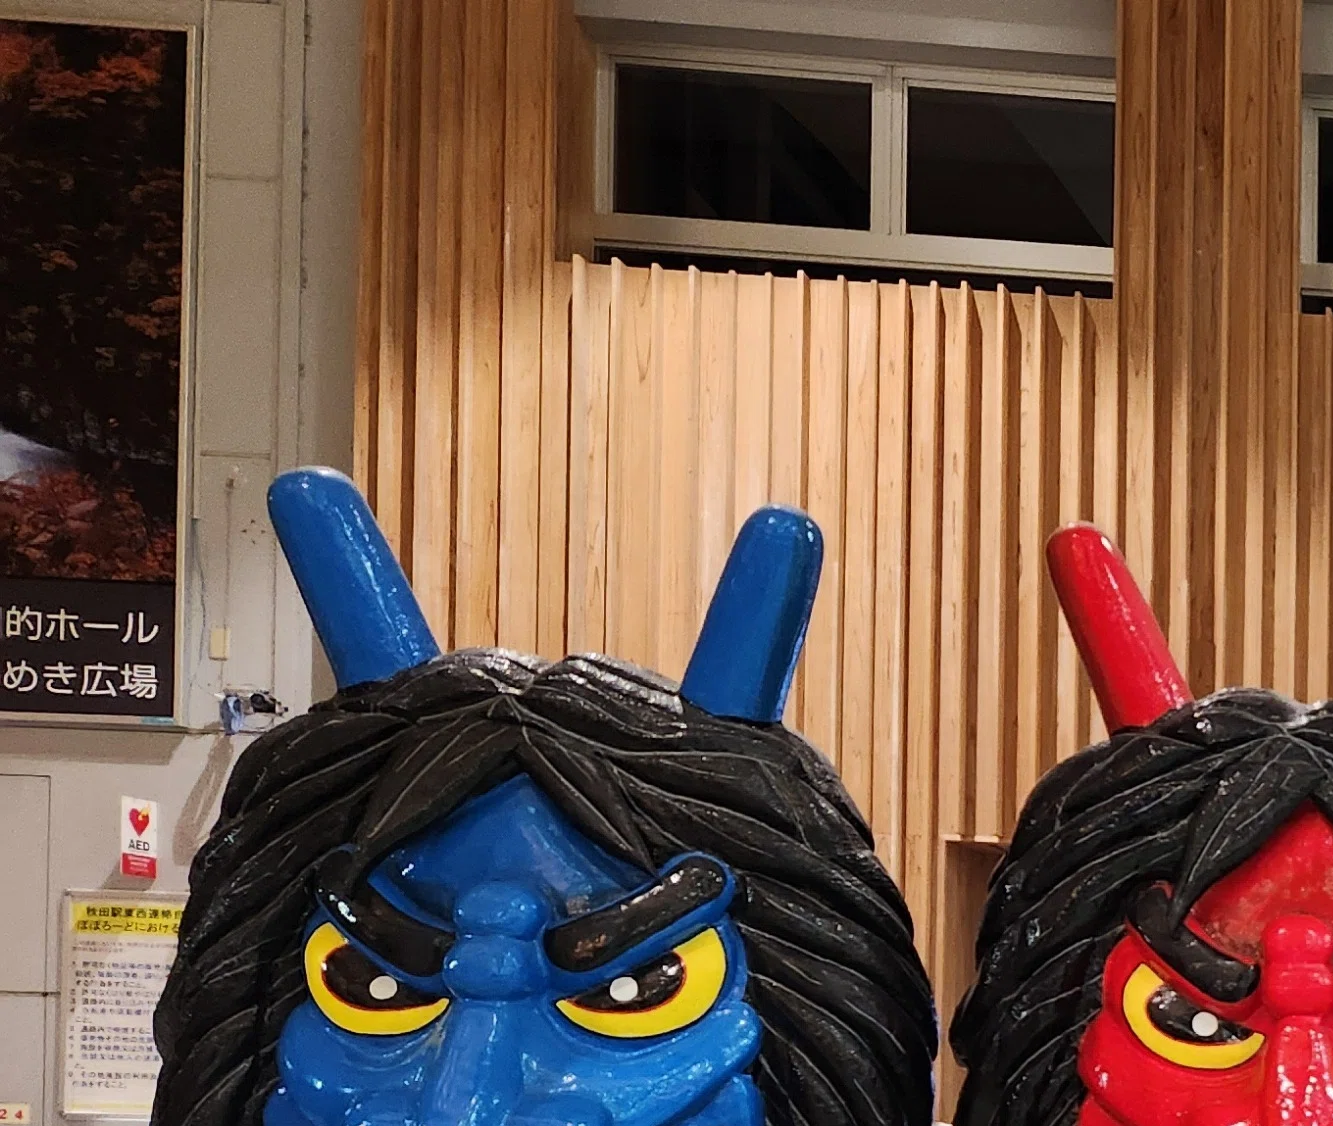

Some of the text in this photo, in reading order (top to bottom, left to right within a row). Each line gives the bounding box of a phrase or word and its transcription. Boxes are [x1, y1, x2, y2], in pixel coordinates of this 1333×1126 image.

[0, 605, 159, 643] 的ホール
[3, 659, 159, 699] めき広場
[128, 839, 150, 852] AED
